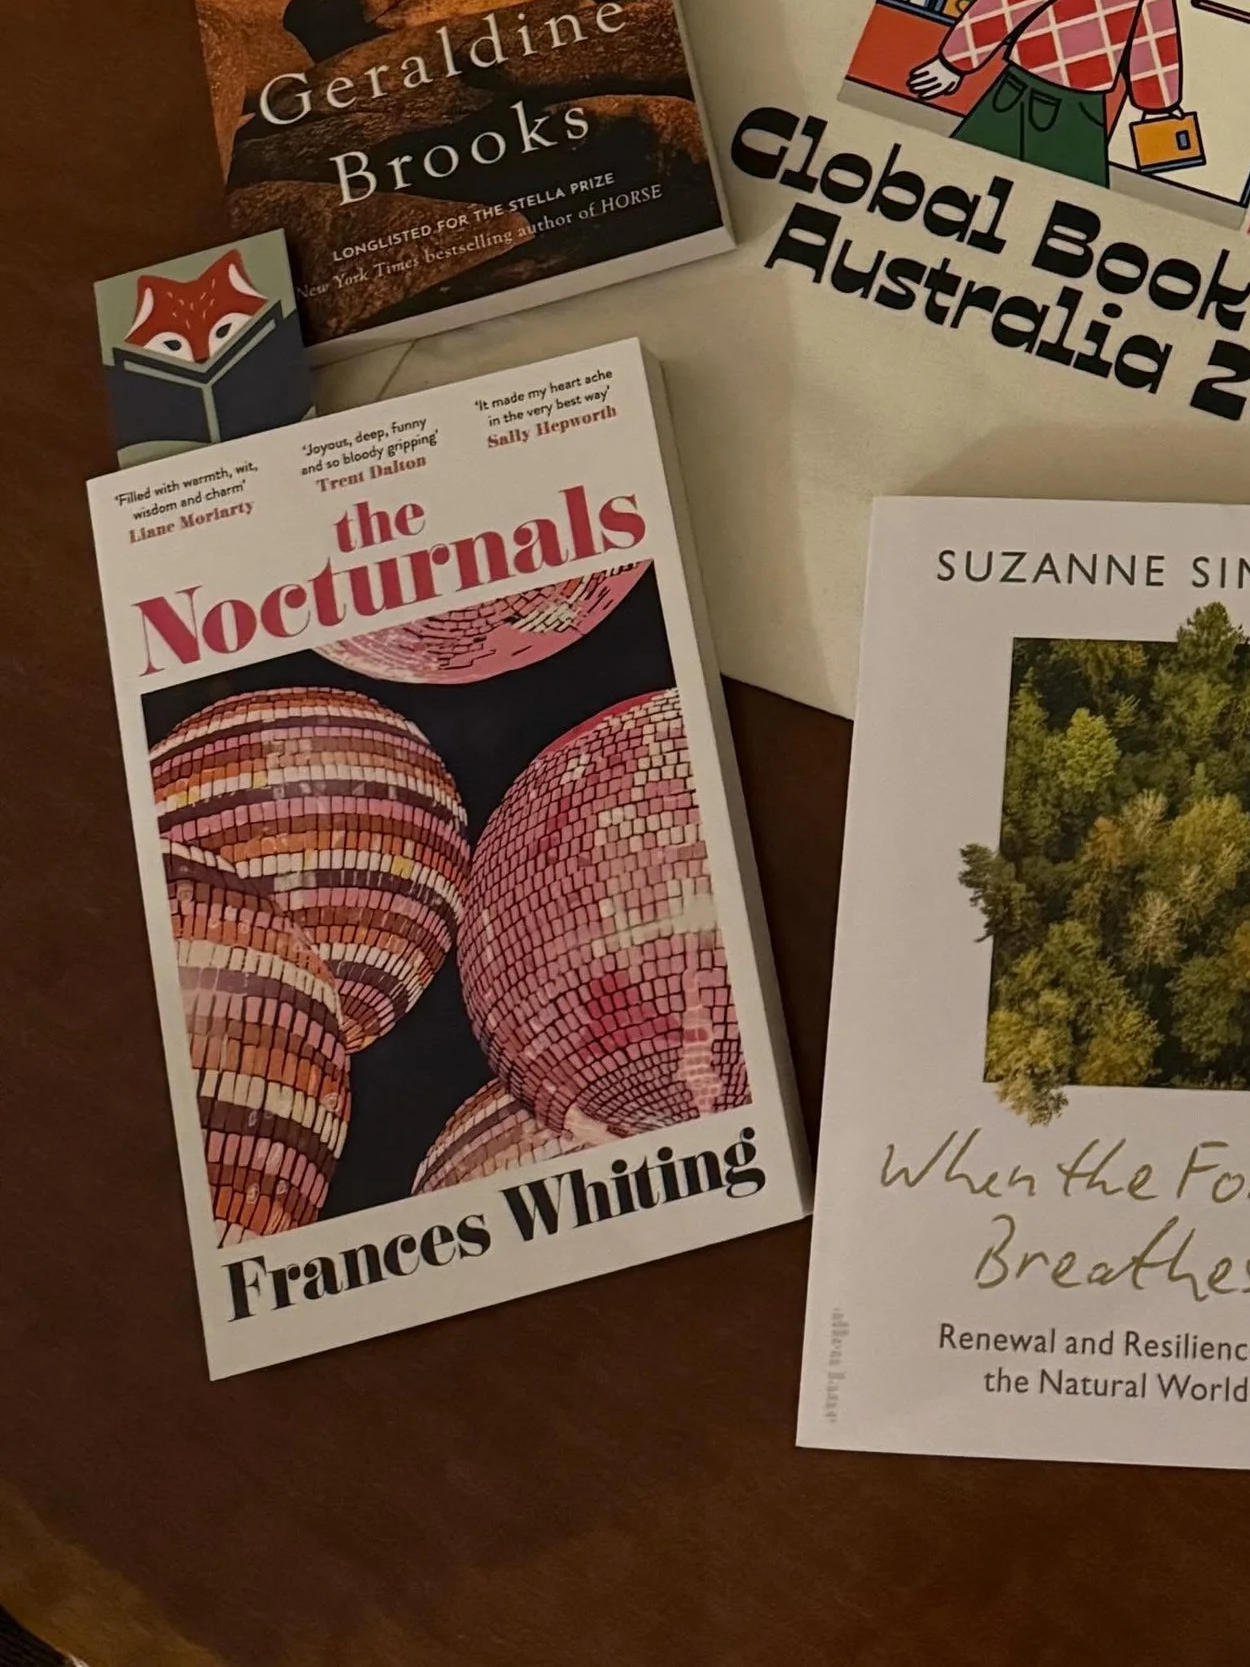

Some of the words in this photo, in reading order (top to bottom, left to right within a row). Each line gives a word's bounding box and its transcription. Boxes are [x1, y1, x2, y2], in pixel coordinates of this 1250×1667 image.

[258, 2, 627, 127] Geraldine
[328, 101, 590, 207] Brooks
[728, 105, 1015, 255] Global
[331, 224, 433, 263] LONGLISTED
[436, 214, 468, 233] FOR
[473, 204, 505, 223] THE
[507, 186, 566, 213] STELLA
[569, 172, 616, 195] PRIZE
[332, 266, 371, 290] York
[373, 252, 421, 278] Times
[423, 227, 514, 267] bestselling
[515, 208, 575, 239] author
[576, 201, 599, 221] of
[598, 183, 664, 214] HORSE
[763, 201, 1174, 395] Australia
[491, 391, 525, 408] made
[527, 388, 547, 400] my
[549, 378, 582, 394] heart
[585, 369, 613, 384] ache
[354, 429, 389, 443] deep,
[391, 418, 427, 434] funny
[487, 429, 529, 448] Sally
[536, 405, 617, 436] Hepworth
[488, 415, 501, 427] in
[503, 411, 524, 423] the
[526, 404, 553, 417] very
[555, 395, 582, 410] best
[154, 480, 180, 496] with
[182, 467, 233, 488] warmth,
[235, 462, 258, 474] wit,
[301, 459, 323, 476] and
[326, 459, 340, 469] so
[342, 445, 384, 465] bloody
[316, 471, 364, 492] Trent
[369, 456, 426, 479] Dalton
[129, 523, 175, 544] Liane
[179, 502, 253, 529] Moriarty
[133, 502, 177, 520] wisdom
[180, 491, 202, 508] and
[333, 500, 428, 555] the
[130, 485, 647, 678] Nocturnals
[936, 549, 1166, 587] SUZANNE
[879, 1128, 1038, 1197] When
[1057, 1138, 1158, 1202] the
[222, 1212, 492, 1323] Frances
[500, 1126, 768, 1242] Whiting
[939, 1323, 1057, 1354] Renewal
[1065, 1329, 1114, 1357] and
[984, 1368, 1029, 1394] the
[1038, 1370, 1146, 1399] Natural
[1158, 1374, 1249, 1403] World
